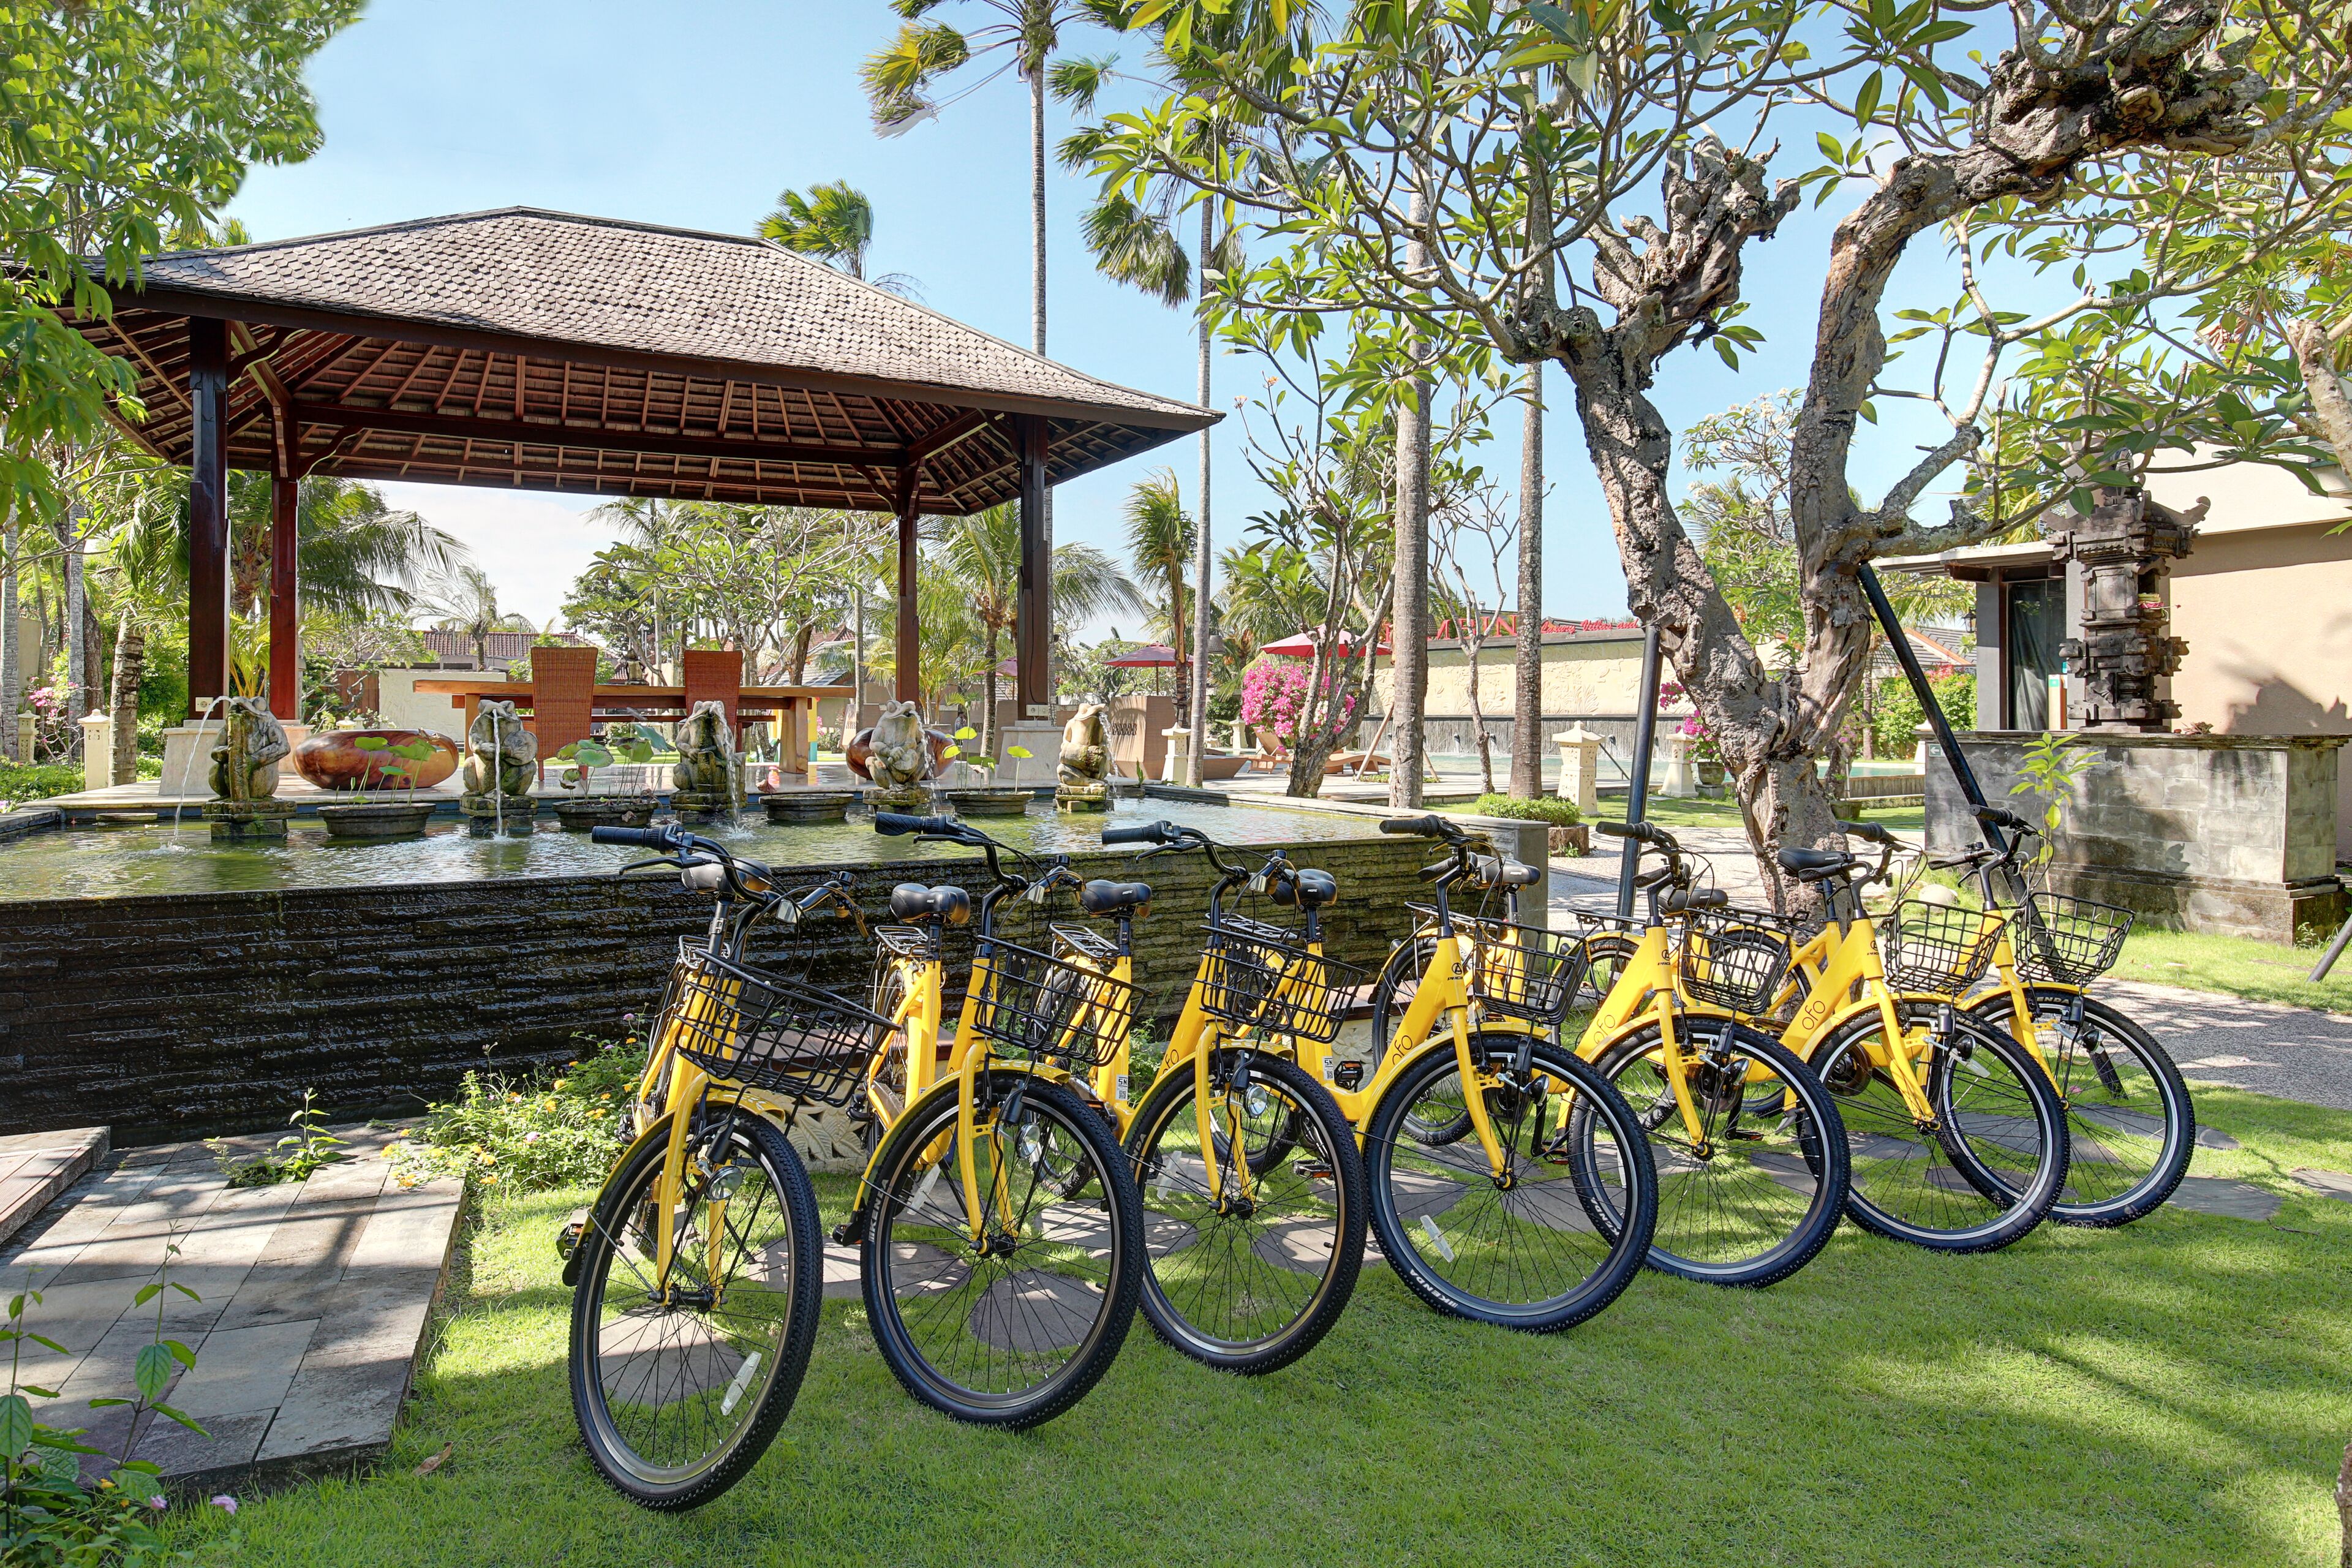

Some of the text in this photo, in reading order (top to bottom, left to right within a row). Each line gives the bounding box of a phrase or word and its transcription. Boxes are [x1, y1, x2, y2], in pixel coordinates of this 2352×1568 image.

[1581, 619, 1613, 631] Villas
[1616, 617, 1639, 629] and
[1802, 1000, 1826, 1030] ofo
[1956, 1017, 1981, 1031] NDA
[1410, 1268, 1451, 1303] KENDA
